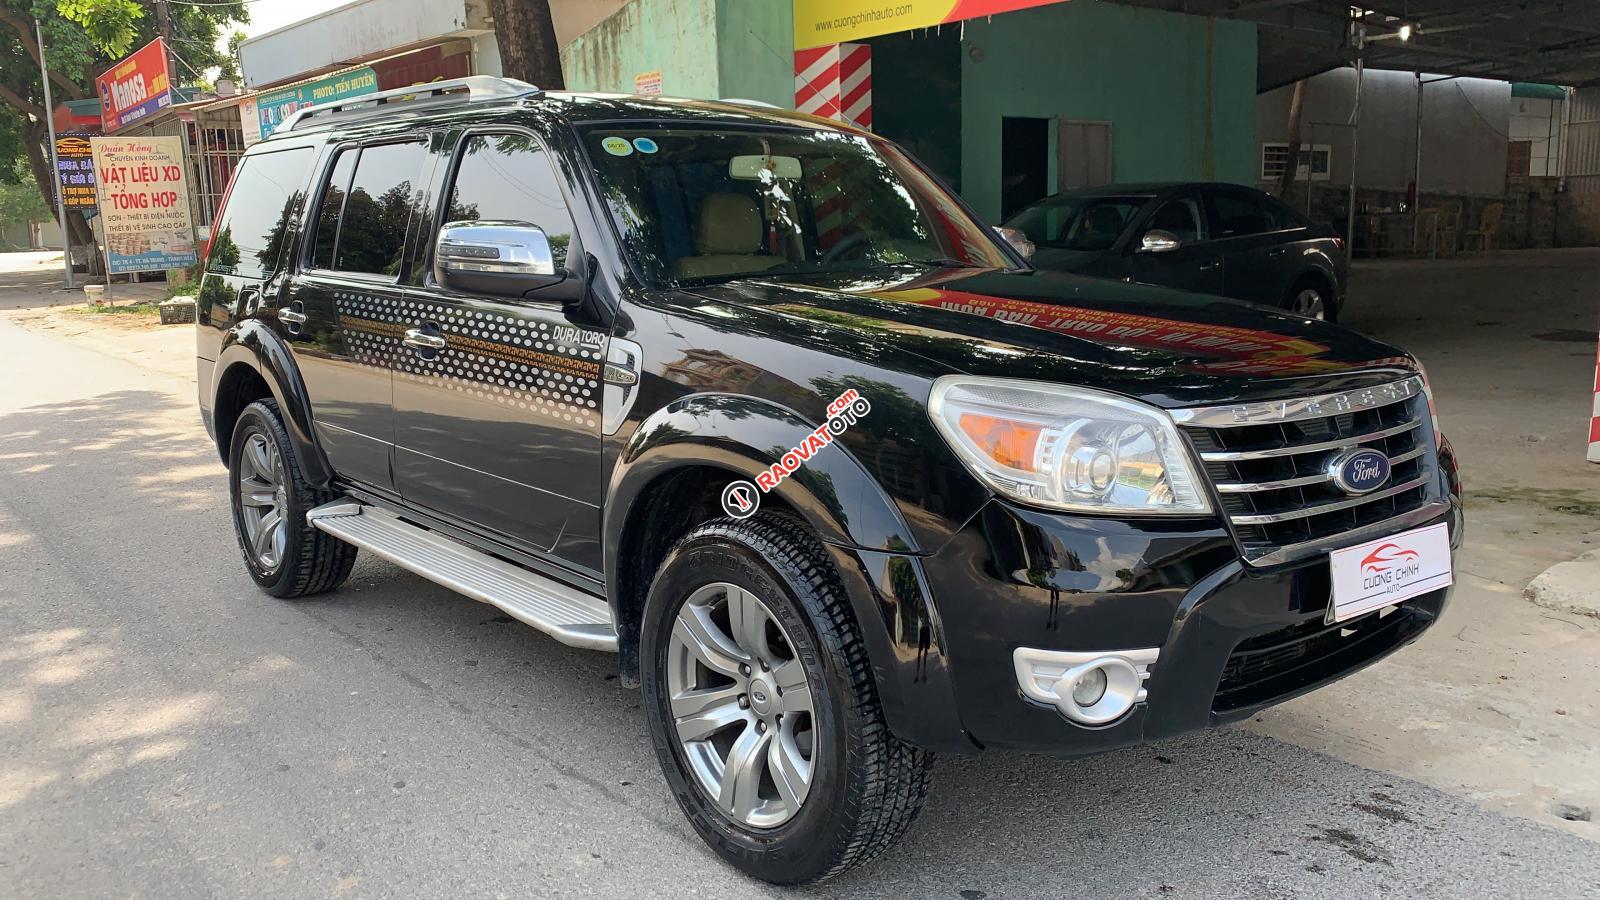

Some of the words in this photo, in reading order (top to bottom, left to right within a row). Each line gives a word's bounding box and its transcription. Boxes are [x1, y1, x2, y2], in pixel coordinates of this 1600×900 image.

[815, 4, 912, 31] www.cuongchinhauto.com
[313, 85, 335, 99] PHOTO:
[101, 163, 127, 189] VẬT
[131, 162, 159, 187] LIỆU
[162, 165, 181, 182] XD
[111, 183, 148, 209] TỔNG
[151, 191, 177, 212] HỢP
[552, 325, 606, 347] DURATORQ
[1352, 458, 1381, 483] Ford
[1364, 571, 1392, 590] CUONG
[1395, 563, 1420, 580] CHINH
[1386, 584, 1400, 594] AUTO
